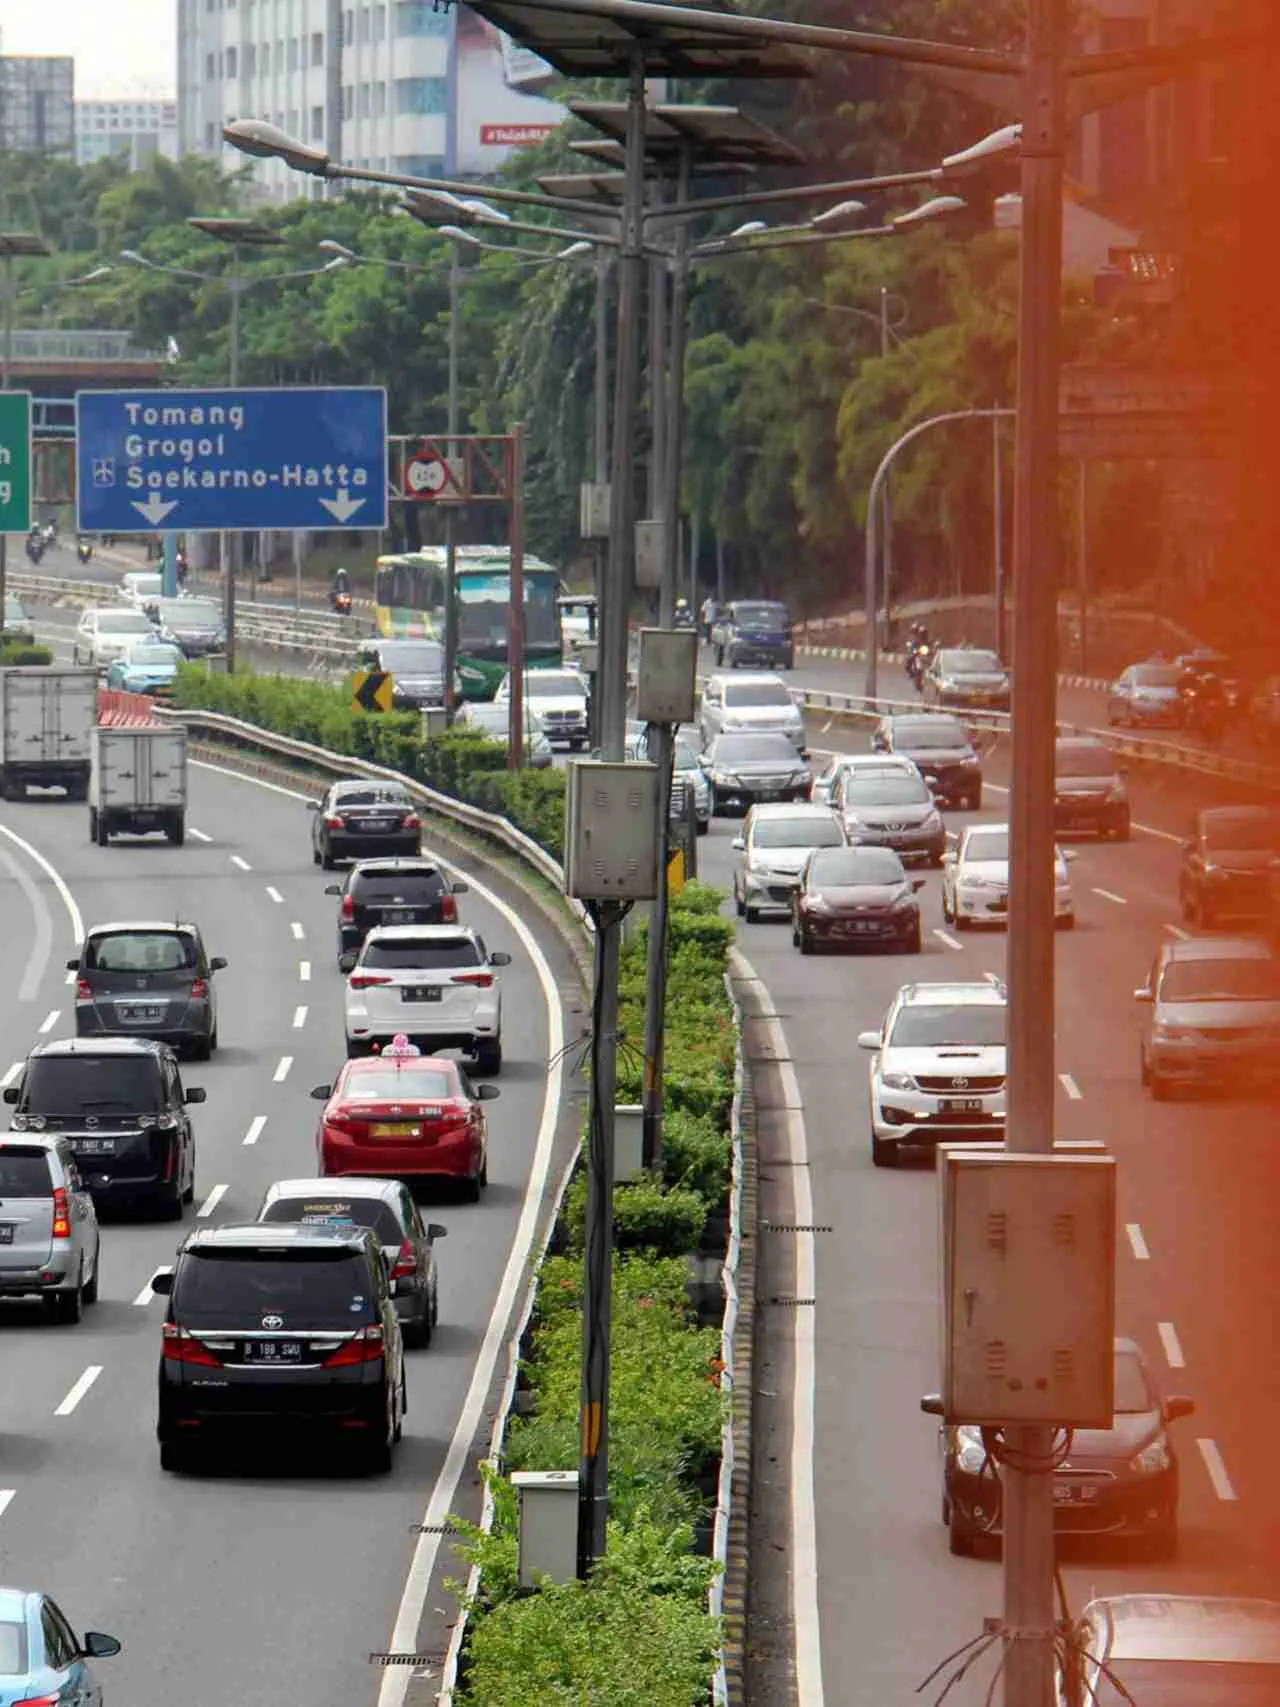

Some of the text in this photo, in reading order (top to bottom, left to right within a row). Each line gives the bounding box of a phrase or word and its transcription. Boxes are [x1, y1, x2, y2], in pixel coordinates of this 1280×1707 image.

[125, 403, 243, 430] Tomang
[125, 434, 224, 461] Grogol
[126, 463, 368, 489] Soekarno-Hatta
